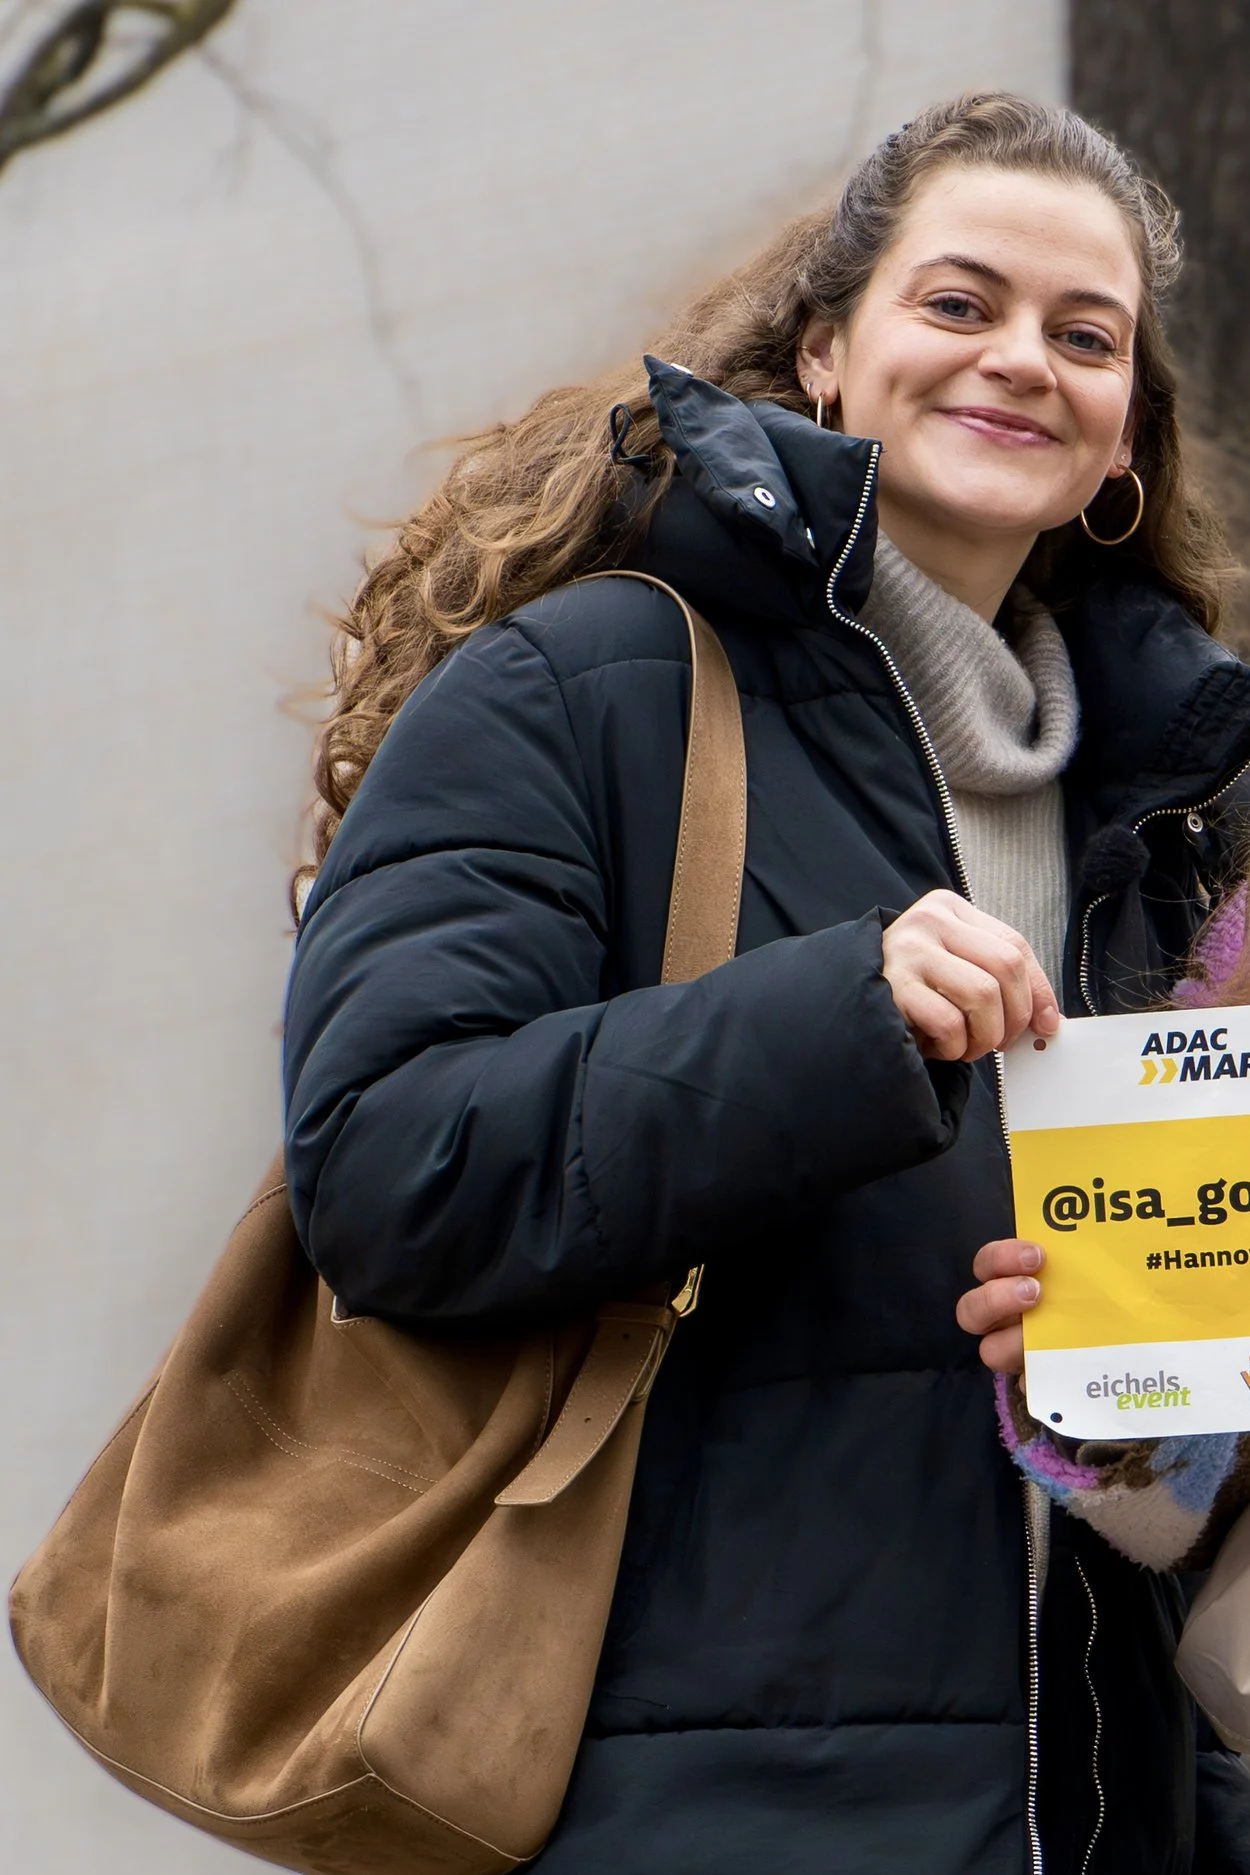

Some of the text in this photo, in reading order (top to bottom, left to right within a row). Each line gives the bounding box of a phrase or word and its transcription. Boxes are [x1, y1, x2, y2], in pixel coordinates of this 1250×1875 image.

[1141, 1028, 1228, 1056] ADAC
[1086, 1370, 1181, 1399] eichels
[1117, 1386, 1191, 1410] event
